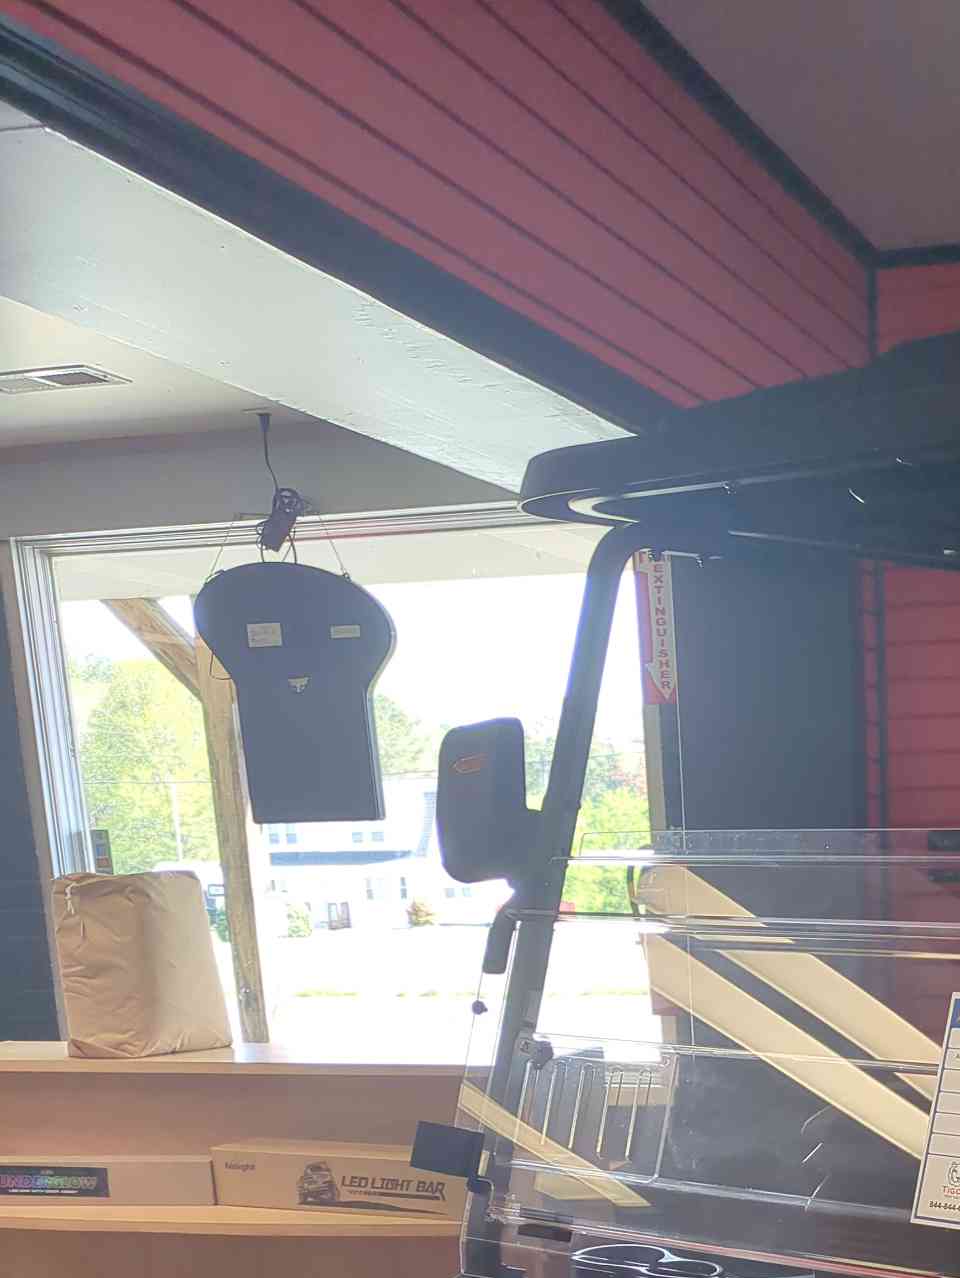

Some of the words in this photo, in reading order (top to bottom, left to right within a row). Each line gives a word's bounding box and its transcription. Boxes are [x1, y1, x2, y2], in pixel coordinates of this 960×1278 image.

[653, 564, 671, 689] EXTINGUISHER
[341, 1175, 368, 1188] LED
[370, 1176, 412, 1191] LIGHT
[416, 1180, 449, 1201] BAR
